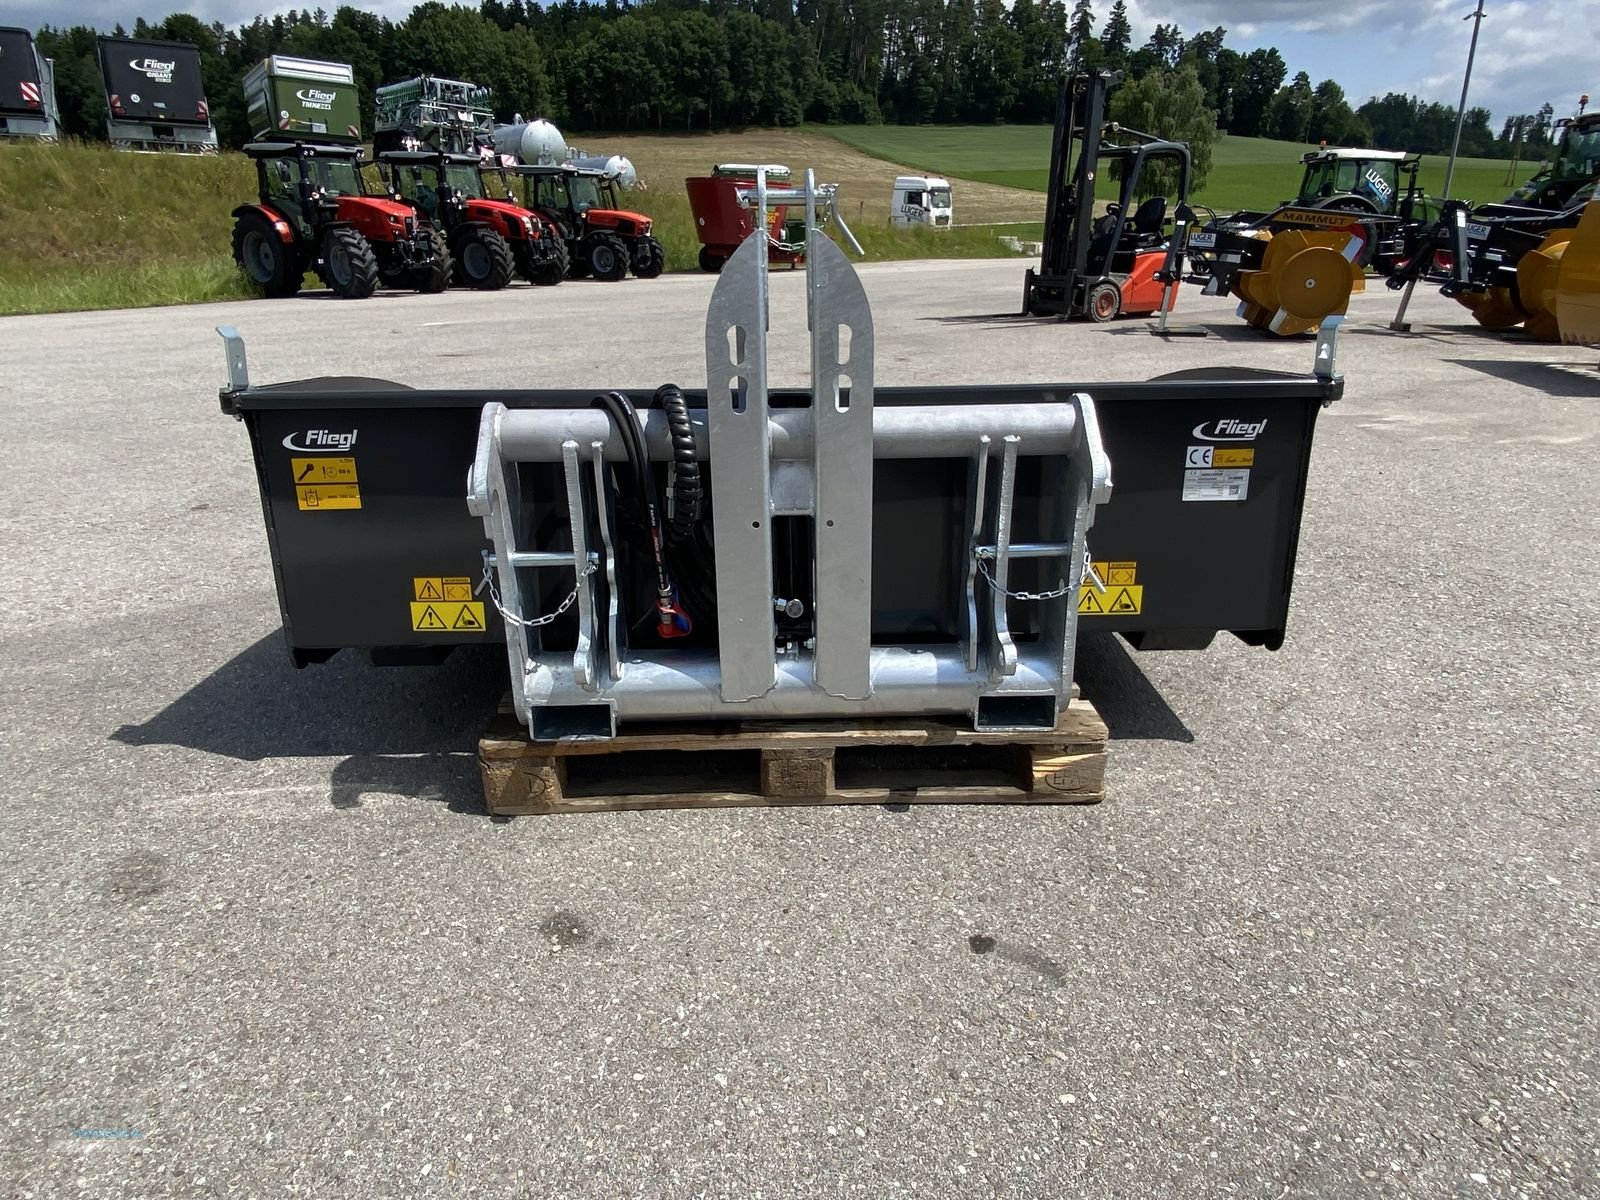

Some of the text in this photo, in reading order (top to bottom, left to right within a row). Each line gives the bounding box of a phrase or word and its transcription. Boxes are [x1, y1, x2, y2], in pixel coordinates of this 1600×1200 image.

[144, 58, 176, 73] Fliegl
[308, 89, 337, 103] Fliegl
[1282, 212, 1346, 226] MAMMUT
[1190, 233, 1213, 241] LUGER
[1214, 418, 1268, 438] Fliegl
[305, 429, 358, 448] Fliegl
[1189, 448, 1211, 465] CE
